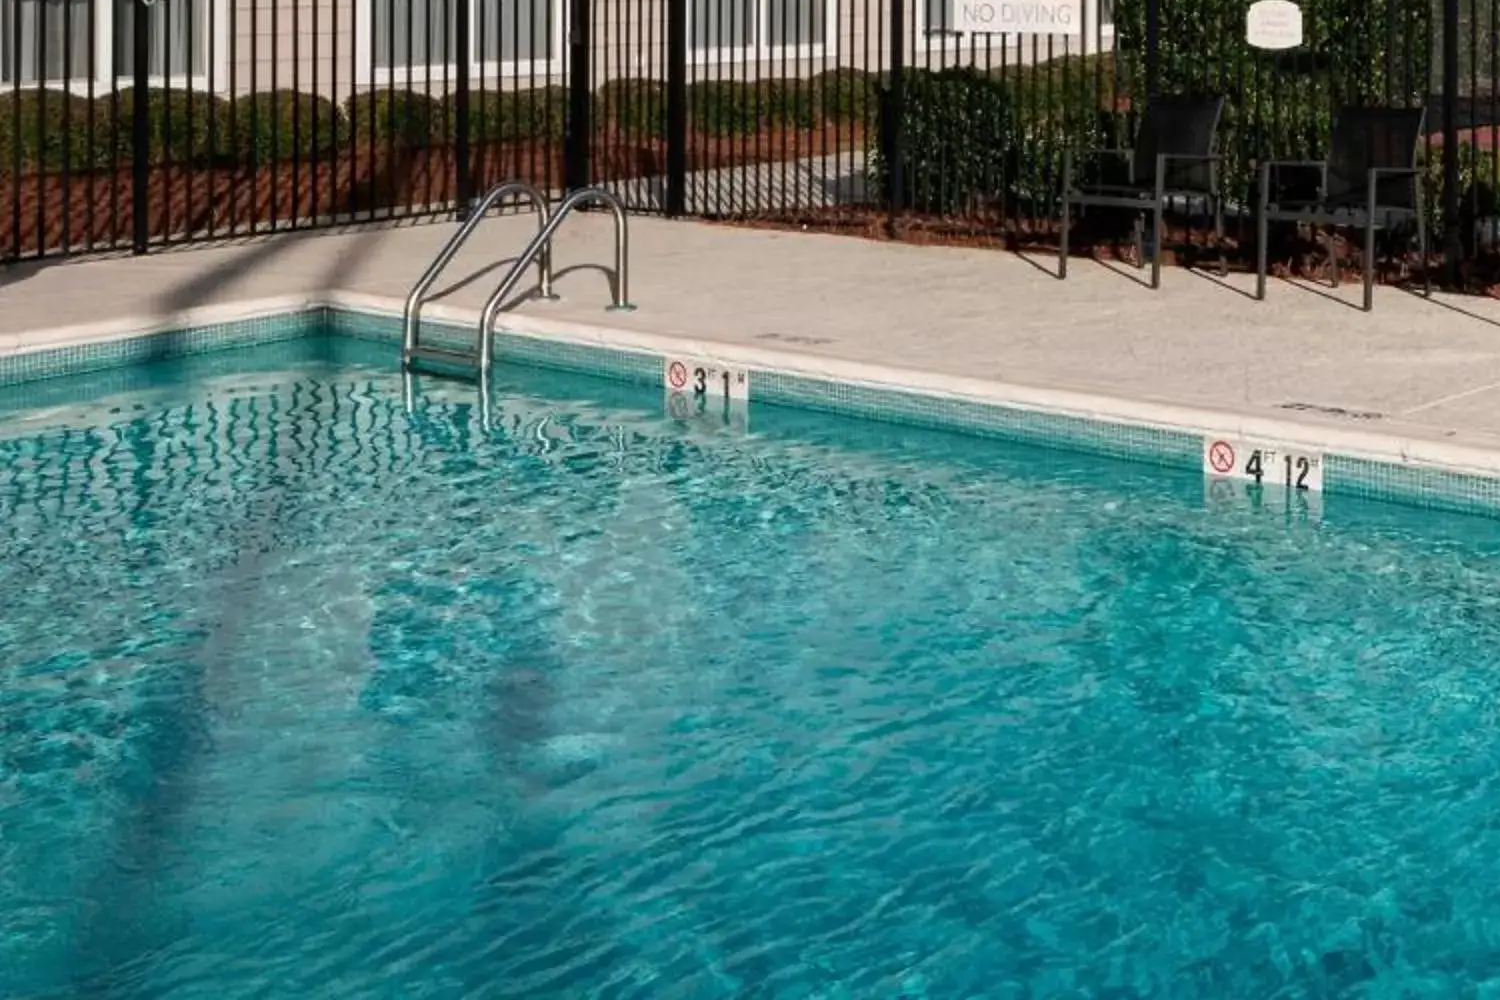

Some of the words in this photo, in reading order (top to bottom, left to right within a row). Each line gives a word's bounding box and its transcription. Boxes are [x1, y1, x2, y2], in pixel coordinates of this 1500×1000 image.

[963, 3, 995, 23] NO
[1001, 3, 1073, 25] DIVING
[694, 367, 707, 393] 3
[722, 371, 730, 398] 1
[1245, 449, 1264, 483] 4
[1284, 455, 1310, 490] 12
